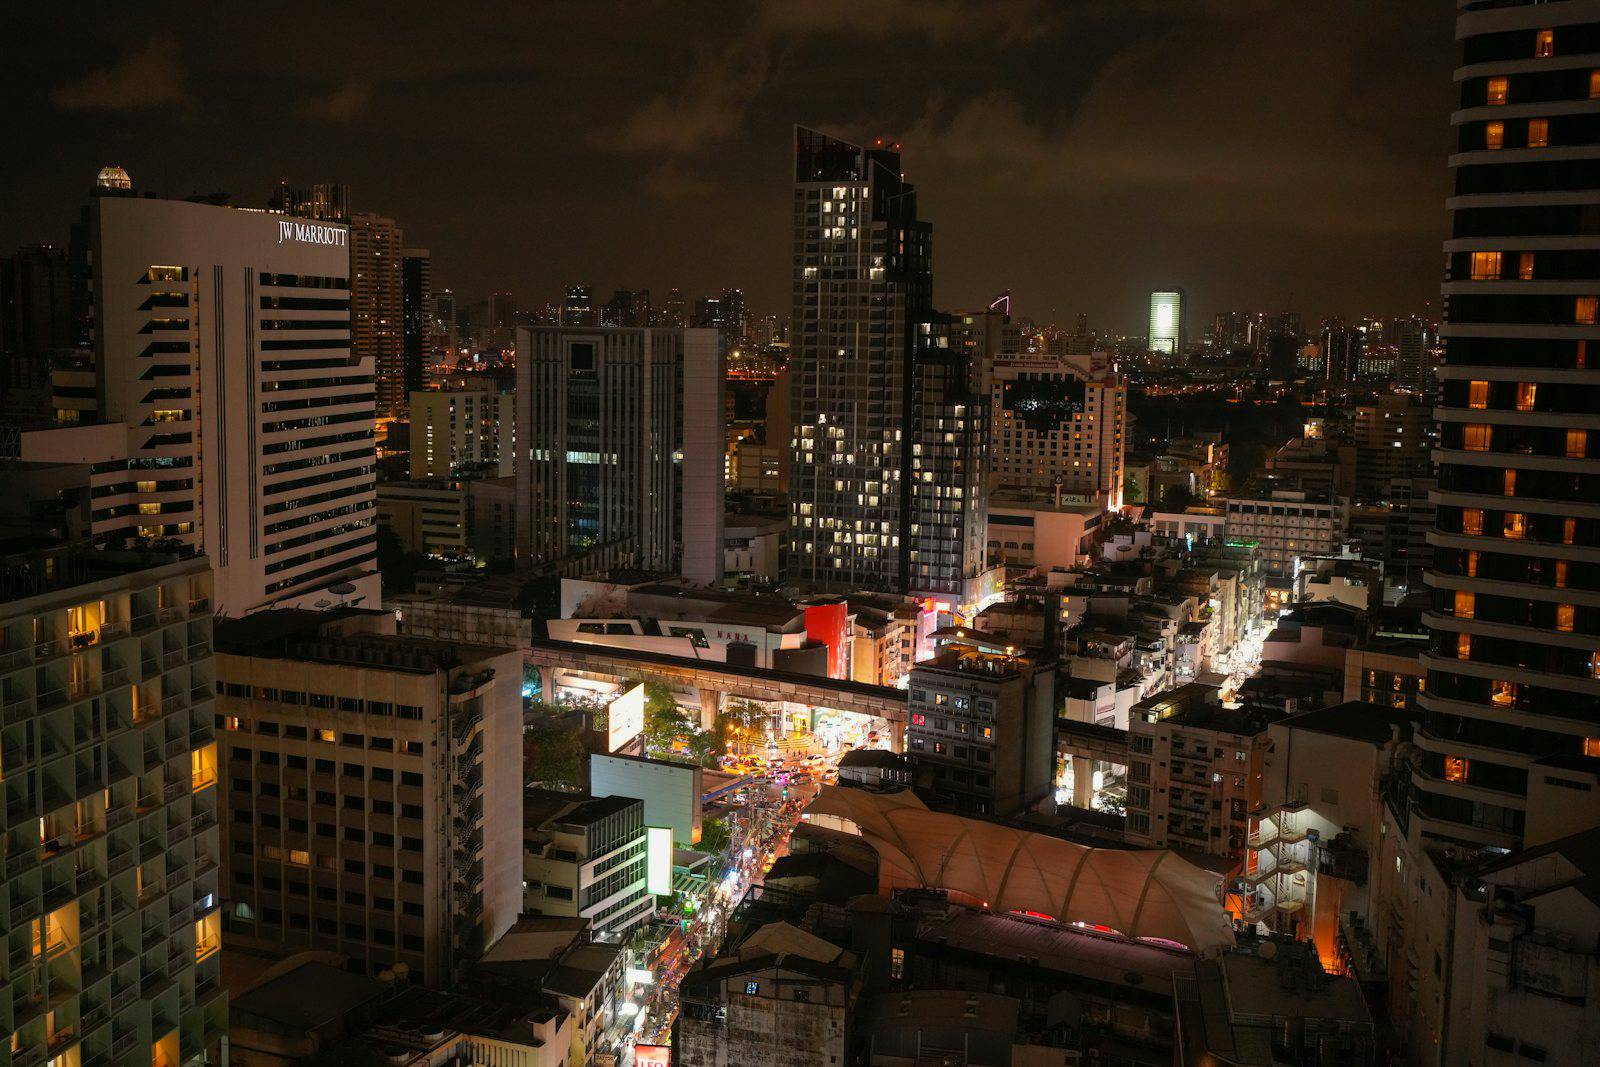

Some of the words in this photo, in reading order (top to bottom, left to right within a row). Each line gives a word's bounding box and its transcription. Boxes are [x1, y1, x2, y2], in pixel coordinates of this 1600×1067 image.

[279, 221, 293, 243] JW
[295, 223, 346, 246] MARRIOTT
[717, 629, 749, 642] NANA
